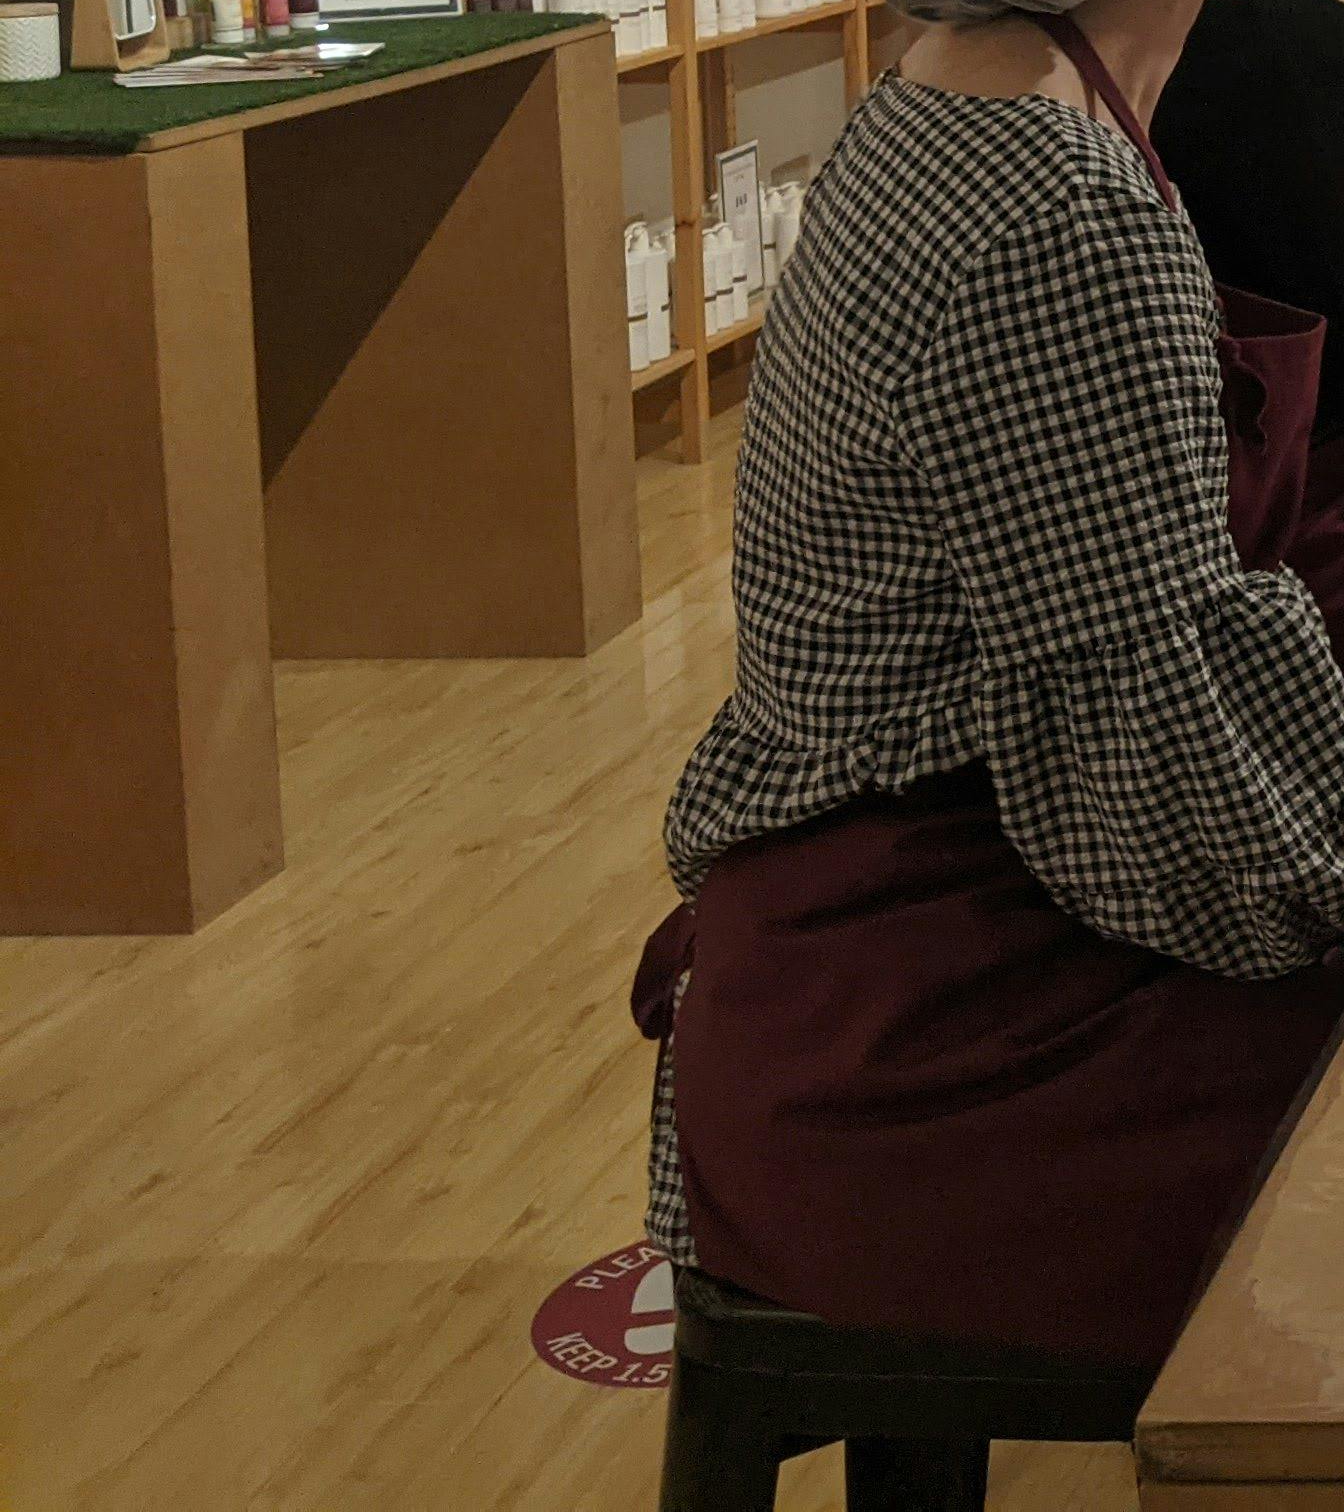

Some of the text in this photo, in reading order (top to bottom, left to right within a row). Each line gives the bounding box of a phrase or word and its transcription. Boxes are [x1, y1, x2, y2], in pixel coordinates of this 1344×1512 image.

[575, 1246, 671, 1289] PLEA
[546, 1332, 673, 1384] KEEP 1.5
